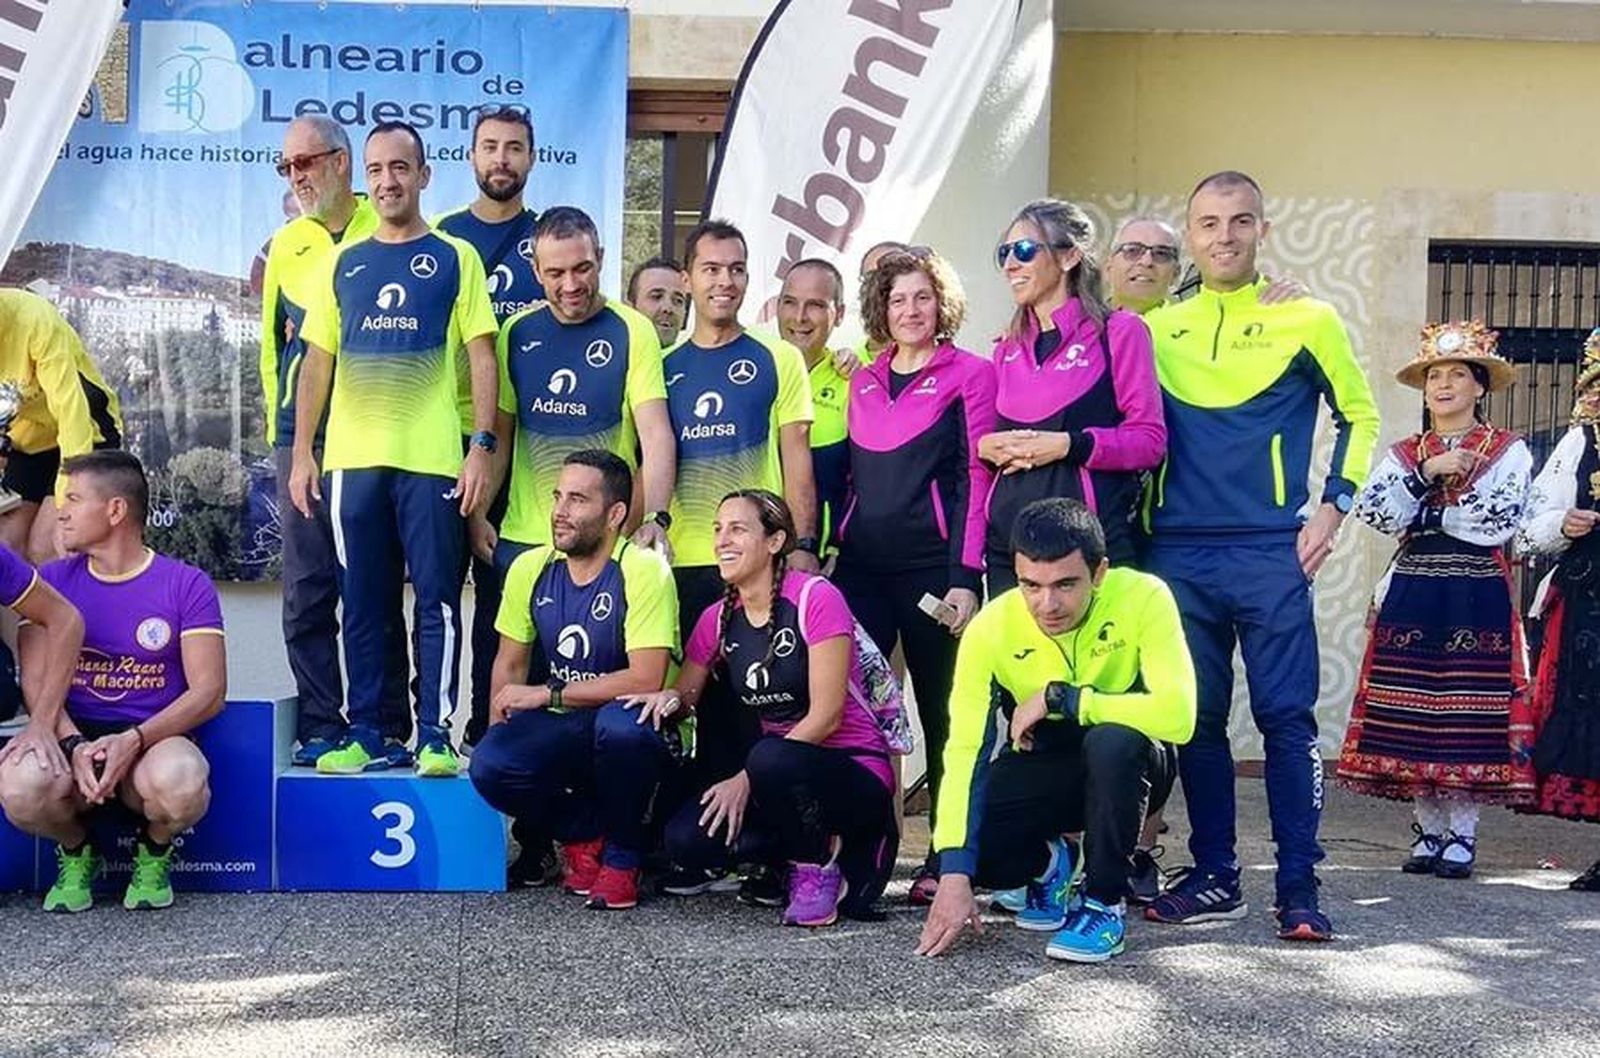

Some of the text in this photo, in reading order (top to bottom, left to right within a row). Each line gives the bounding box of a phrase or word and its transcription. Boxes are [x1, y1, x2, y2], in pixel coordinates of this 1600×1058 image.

[482, 74, 524, 96] de
[261, 89, 532, 131] Ledesm
[77, 145, 132, 164] agua
[140, 144, 193, 162] hace
[200, 144, 284, 164] historia
[538, 145, 577, 165] tiva
[762, 0, 952, 305] rbank
[360, 314, 419, 331] Adarsa
[531, 397, 588, 416] Adarsa
[680, 423, 737, 441] Adarsa
[115, 655, 166, 675] Ruano
[93, 673, 166, 690] Macotera
[370, 801, 416, 868] 3
